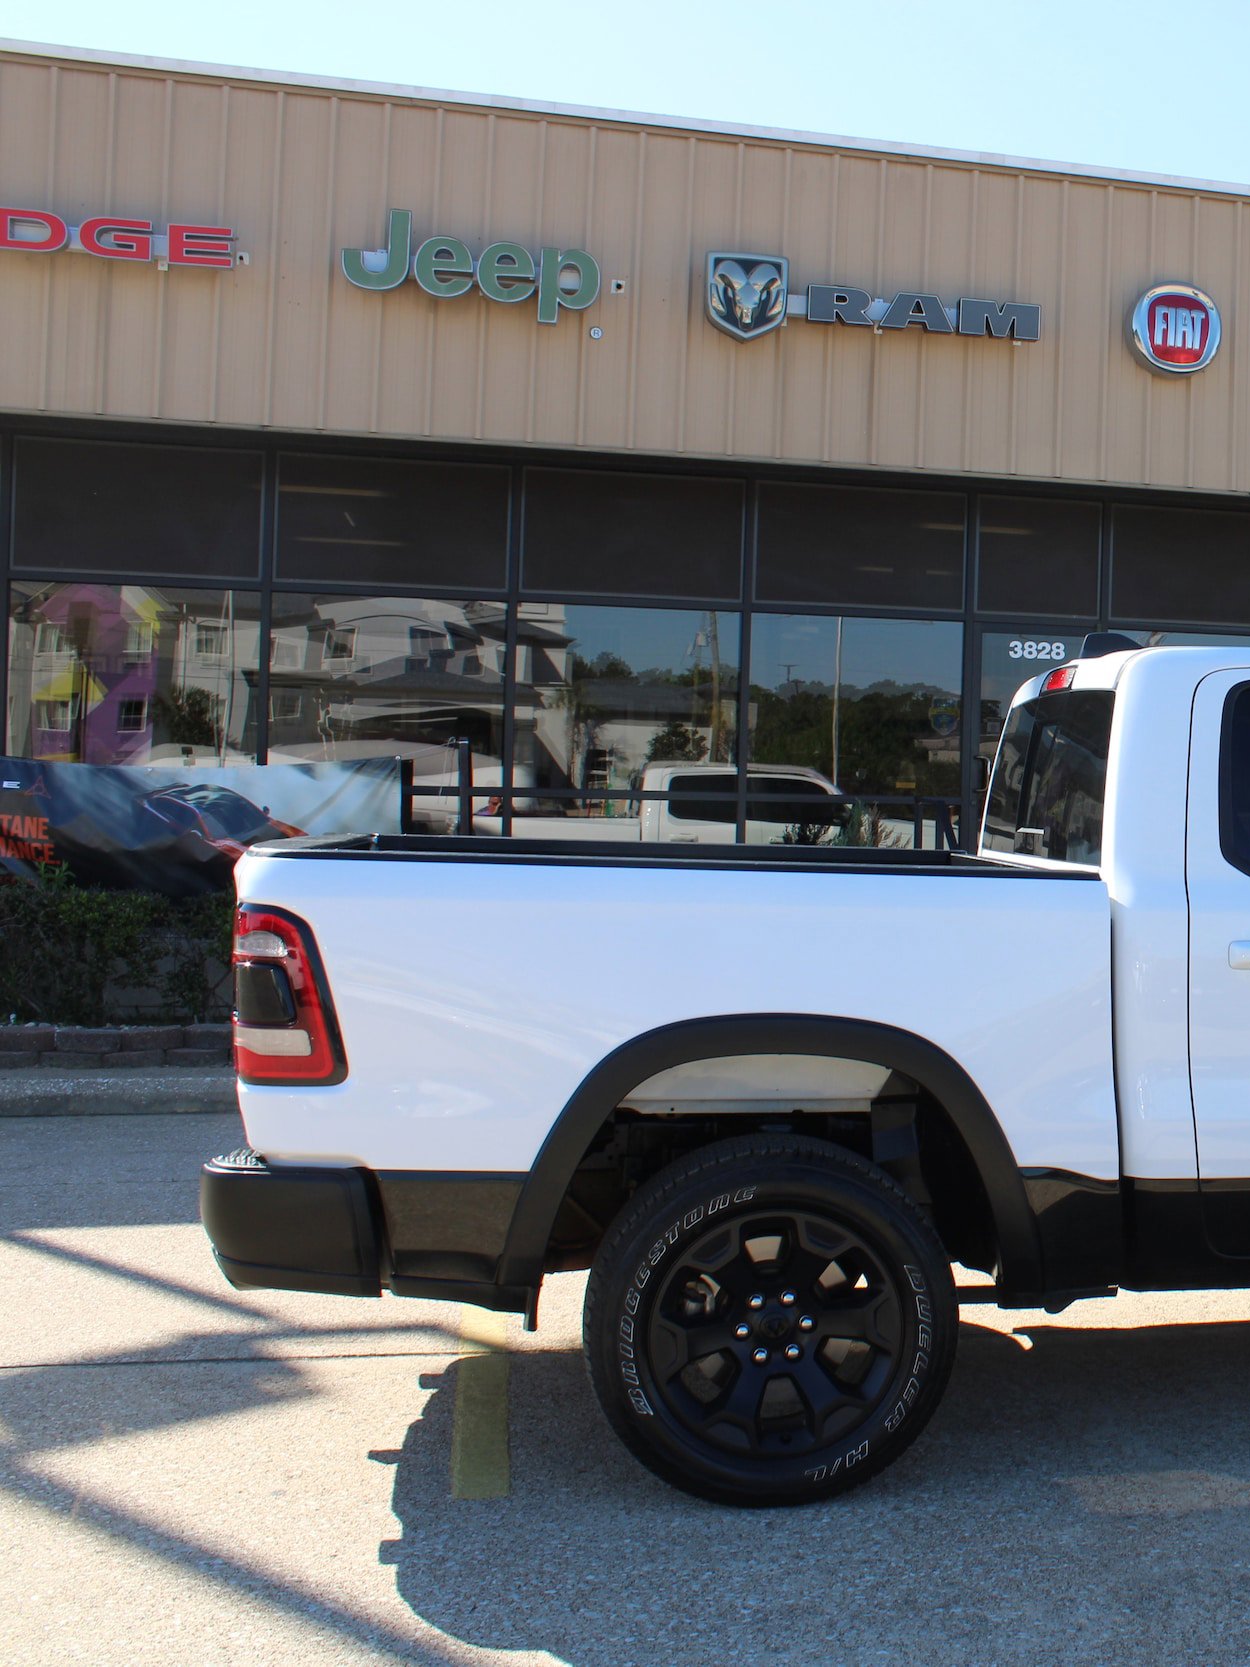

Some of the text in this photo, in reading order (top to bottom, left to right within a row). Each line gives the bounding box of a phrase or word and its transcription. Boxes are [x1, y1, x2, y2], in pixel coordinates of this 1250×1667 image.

[341, 207, 601, 326] Jeep
[806, 283, 1042, 341] RAM
[1153, 304, 1206, 350] FIAT
[1008, 640, 1066, 660] 3828
[619, 1185, 759, 1416] BRIDGESTONE
[804, 1264, 933, 1482] DUELER H/L
